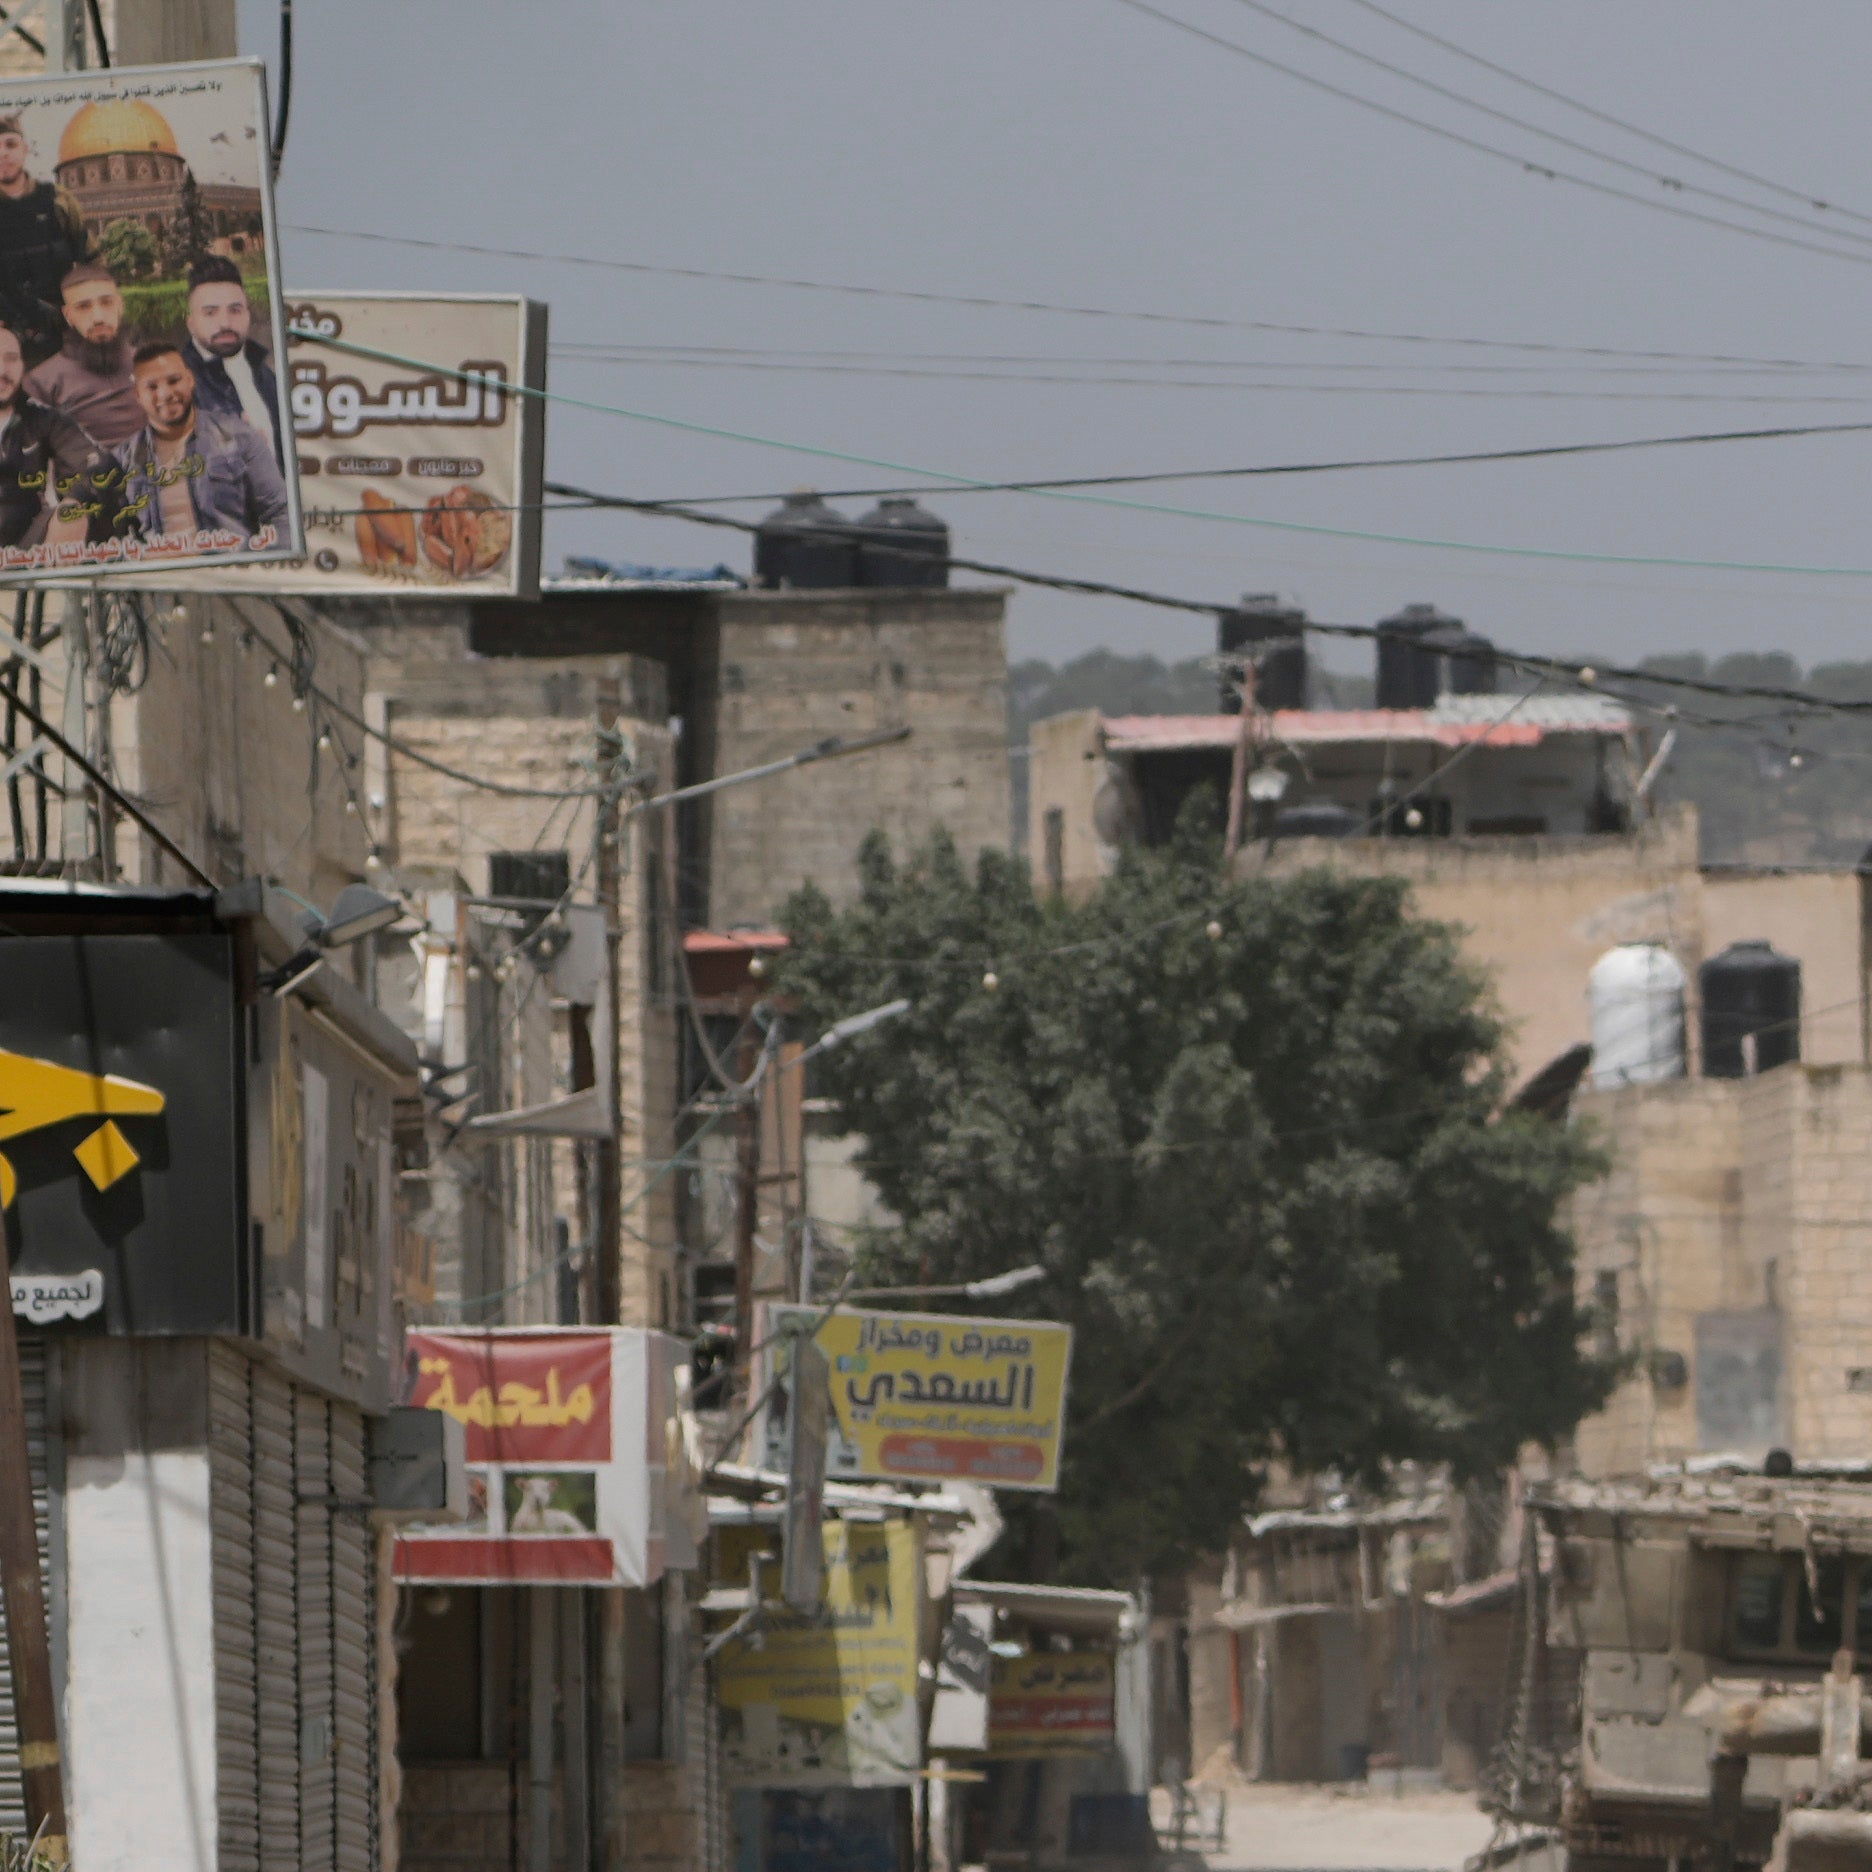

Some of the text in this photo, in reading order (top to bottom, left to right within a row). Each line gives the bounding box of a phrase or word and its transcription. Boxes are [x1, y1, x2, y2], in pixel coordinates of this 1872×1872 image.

[290, 366, 501, 434] السوق
[32, 1280, 92, 1311] لجميع
[950, 1326, 1032, 1362] معرض
[418, 1356, 596, 1430] ملحمة
[846, 1363, 1034, 1422] السعدي
